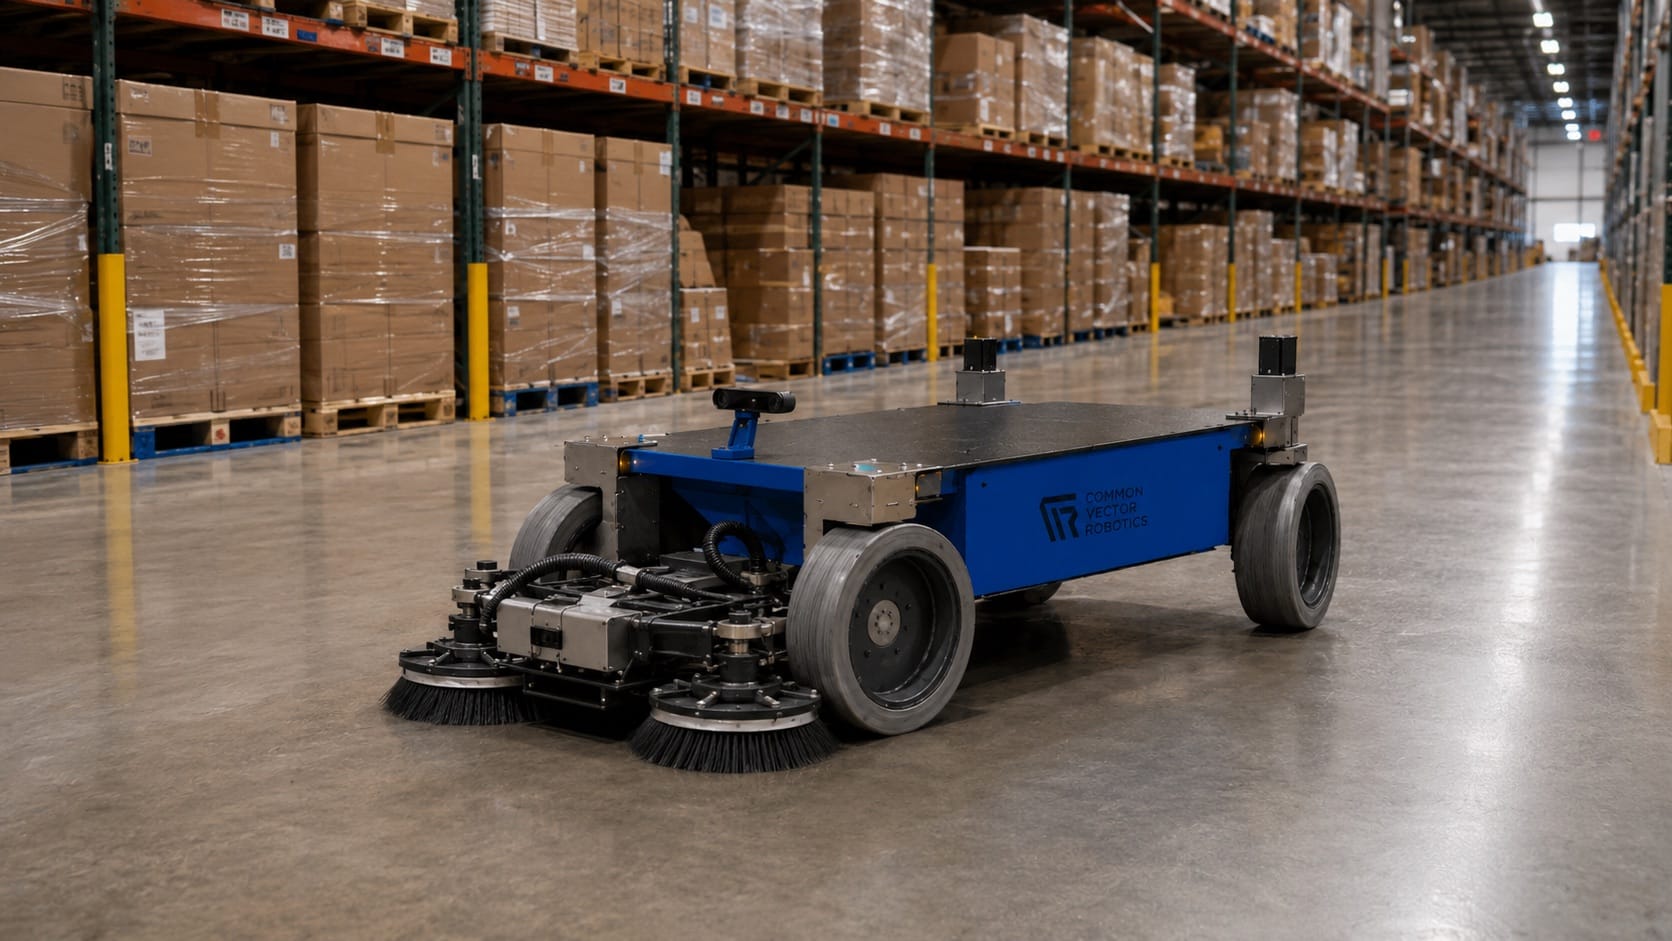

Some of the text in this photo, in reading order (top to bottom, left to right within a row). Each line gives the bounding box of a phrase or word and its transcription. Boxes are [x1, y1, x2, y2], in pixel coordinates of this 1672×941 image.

[1086, 486, 1144, 504] COMMON
[1086, 502, 1137, 519] VECTOR
[1085, 515, 1148, 536] ROBOTICS
